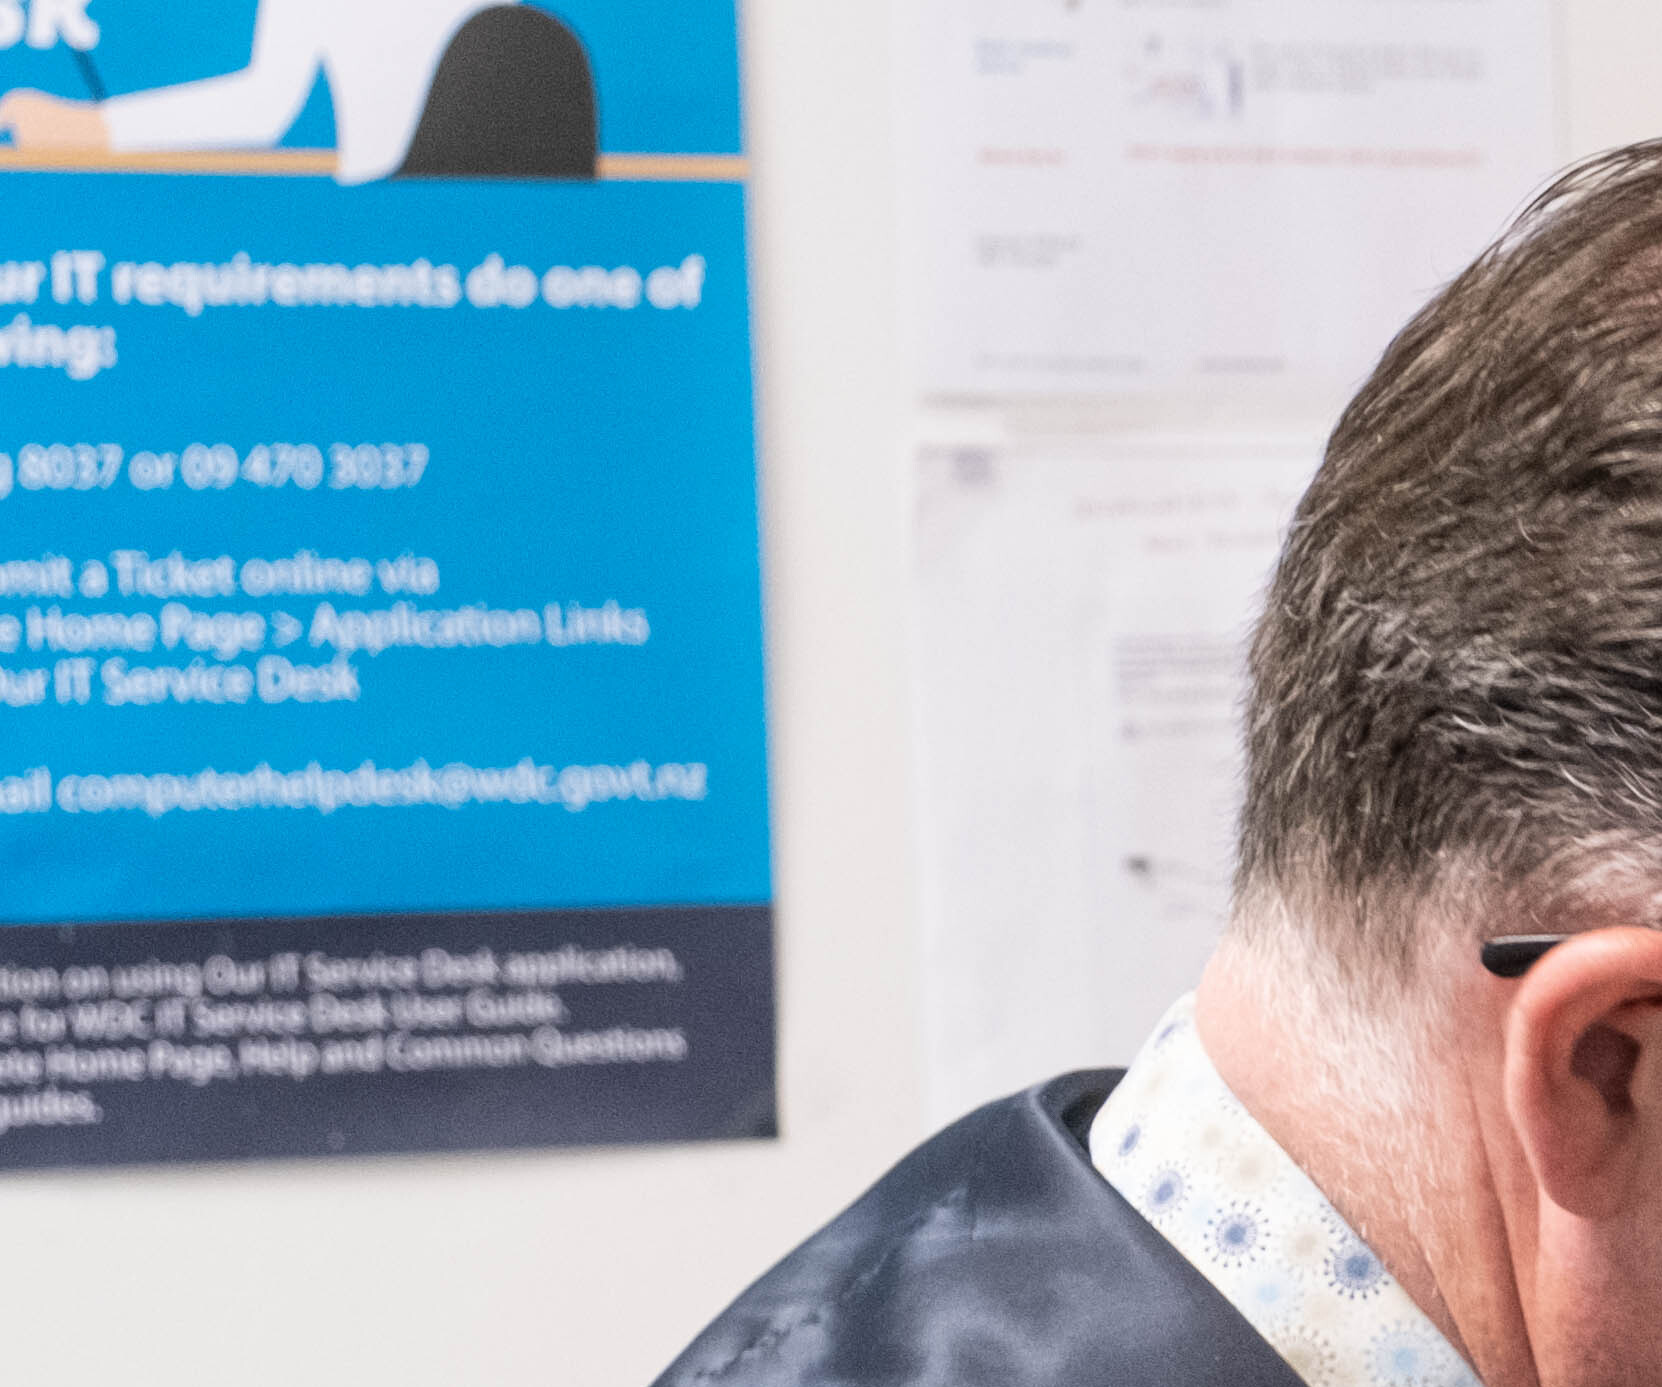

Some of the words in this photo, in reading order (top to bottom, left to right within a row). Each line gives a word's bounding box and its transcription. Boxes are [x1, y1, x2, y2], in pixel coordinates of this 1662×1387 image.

[51, 250, 106, 304] IT
[111, 251, 461, 316] requirements
[465, 252, 538, 309] do
[541, 266, 642, 309] one
[646, 253, 706, 309] of
[18, 443, 124, 490] 8037
[128, 451, 178, 490] or
[180, 443, 239, 490] 09
[241, 443, 325, 490] 470
[328, 443, 430, 490] 3037
[78, 559, 109, 598] a
[108, 549, 236, 598] Ticket
[240, 553, 374, 597] online
[378, 556, 440, 597] via
[25, 603, 157, 653] Home
[159, 601, 265, 661] Page
[309, 601, 541, 657] Application
[542, 599, 650, 647] Links
[54, 656, 98, 706] IT
[101, 656, 254, 706] Service
[256, 650, 361, 703] Desk
[61, 964, 109, 1001] on
[109, 958, 202, 1001] using
[202, 954, 266, 998] Our
[303, 950, 417, 992] Service
[419, 945, 500, 989] Desk
[190, 997, 306, 1039] Service
[309, 990, 390, 1034] Desk
[392, 991, 463, 1031] User
[45, 1045, 146, 1083] Home
[238, 1036, 321, 1082] Help
[321, 1036, 385, 1076] and
[386, 1032, 531, 1072] Common
[530, 1023, 688, 1071] Questions
